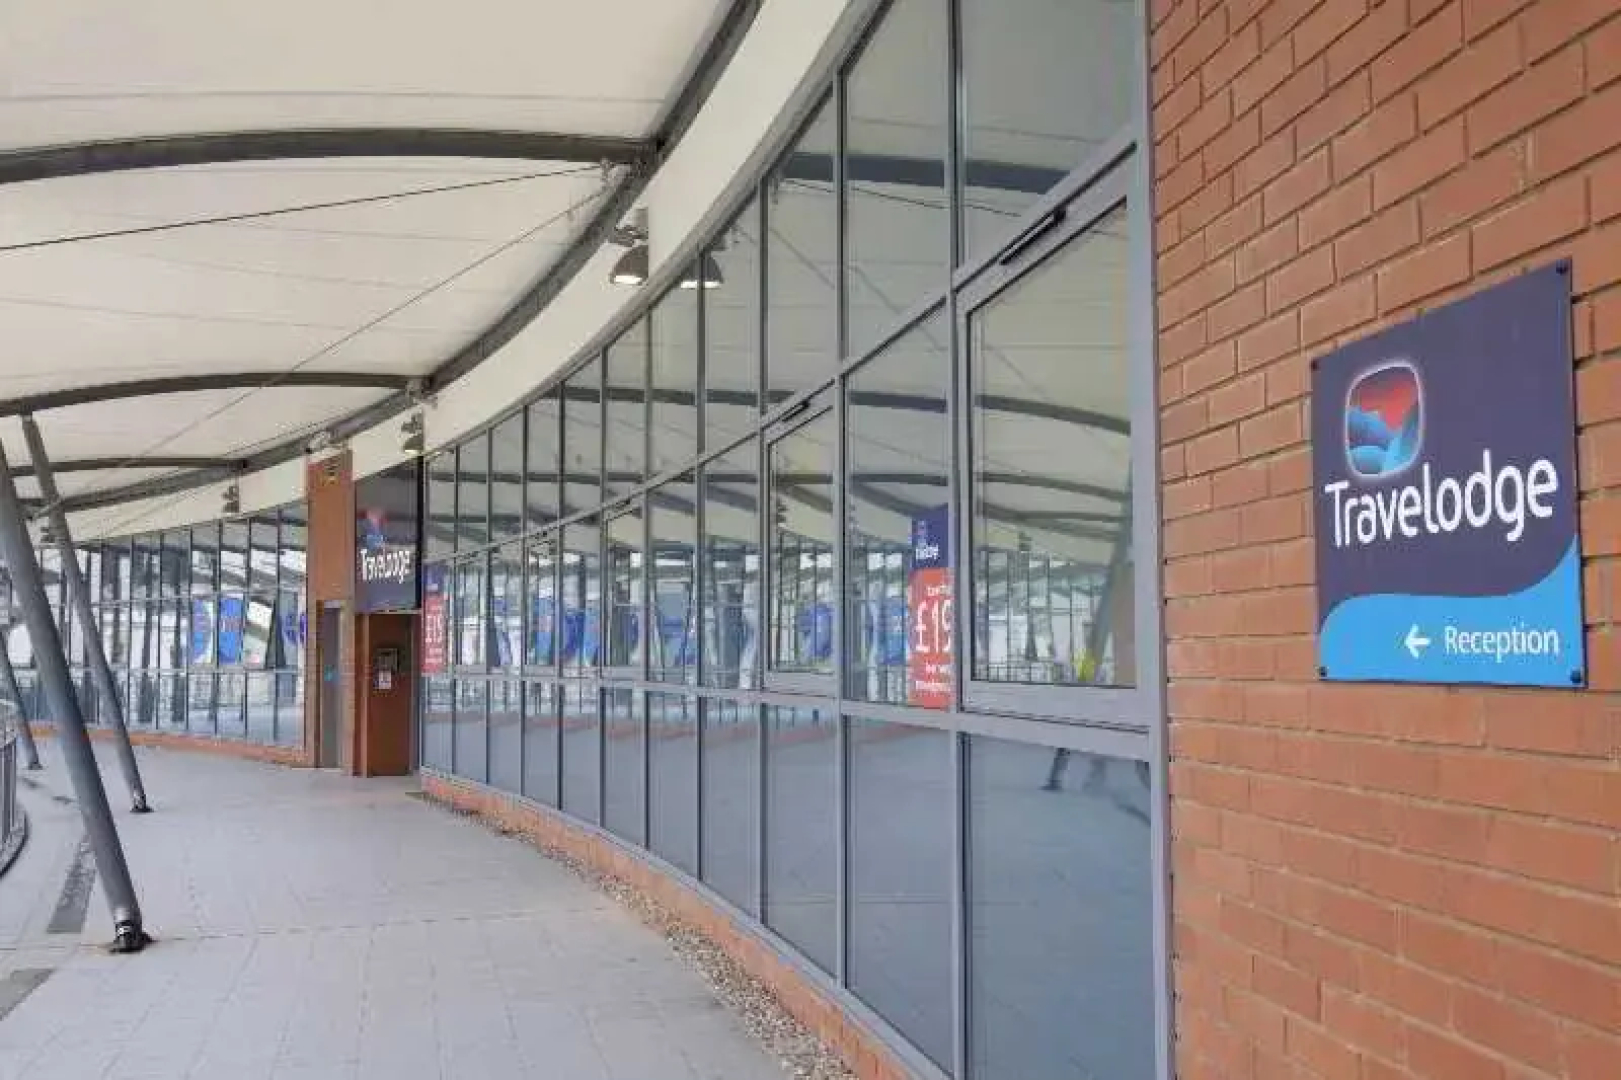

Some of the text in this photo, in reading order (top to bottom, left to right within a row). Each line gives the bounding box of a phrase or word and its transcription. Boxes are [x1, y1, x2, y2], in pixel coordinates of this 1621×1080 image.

[1325, 449, 1559, 548] Travelodge
[360, 547, 411, 583] Travelodge
[1445, 623, 1560, 663] Reception
